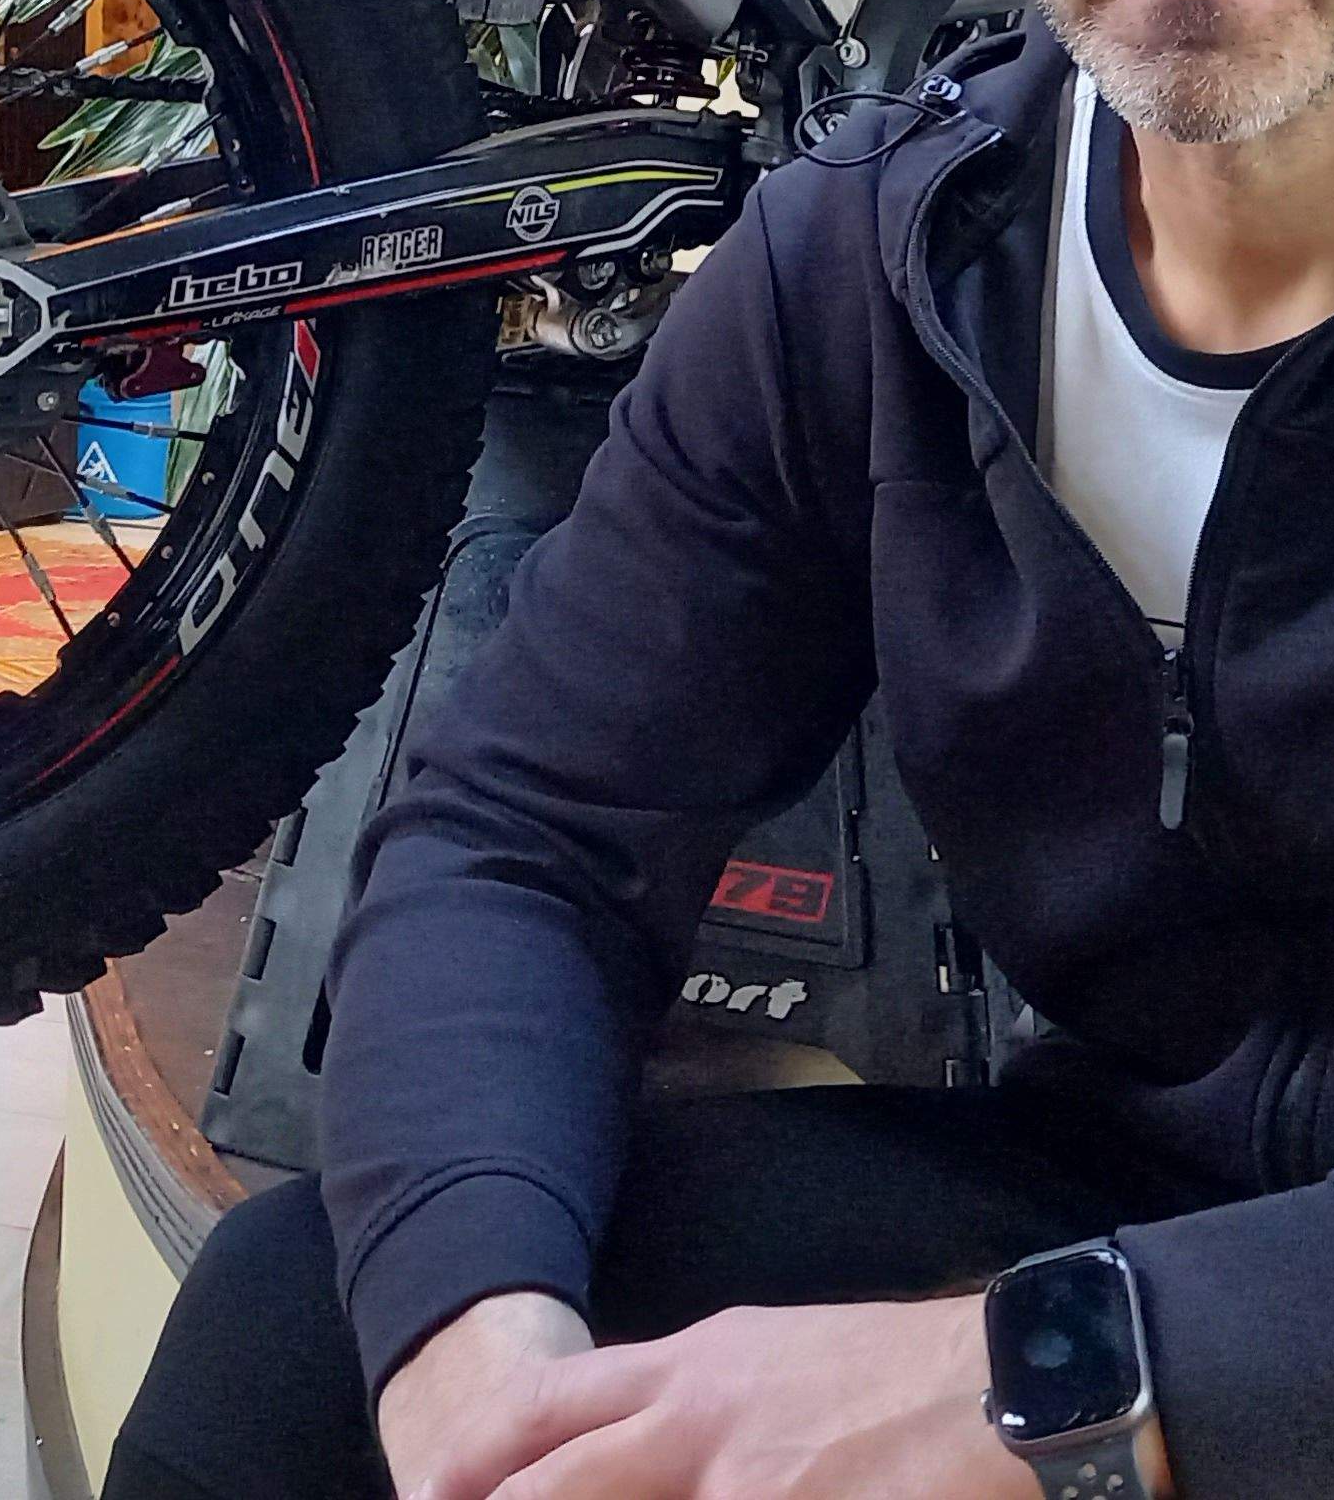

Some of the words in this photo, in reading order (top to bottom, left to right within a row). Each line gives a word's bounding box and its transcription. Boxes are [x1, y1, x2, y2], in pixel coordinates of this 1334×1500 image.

[507, 200, 560, 228] NILS
[362, 225, 443, 267] REIGER
[169, 261, 302, 307] hebo
[680, 973, 807, 1019] ort
